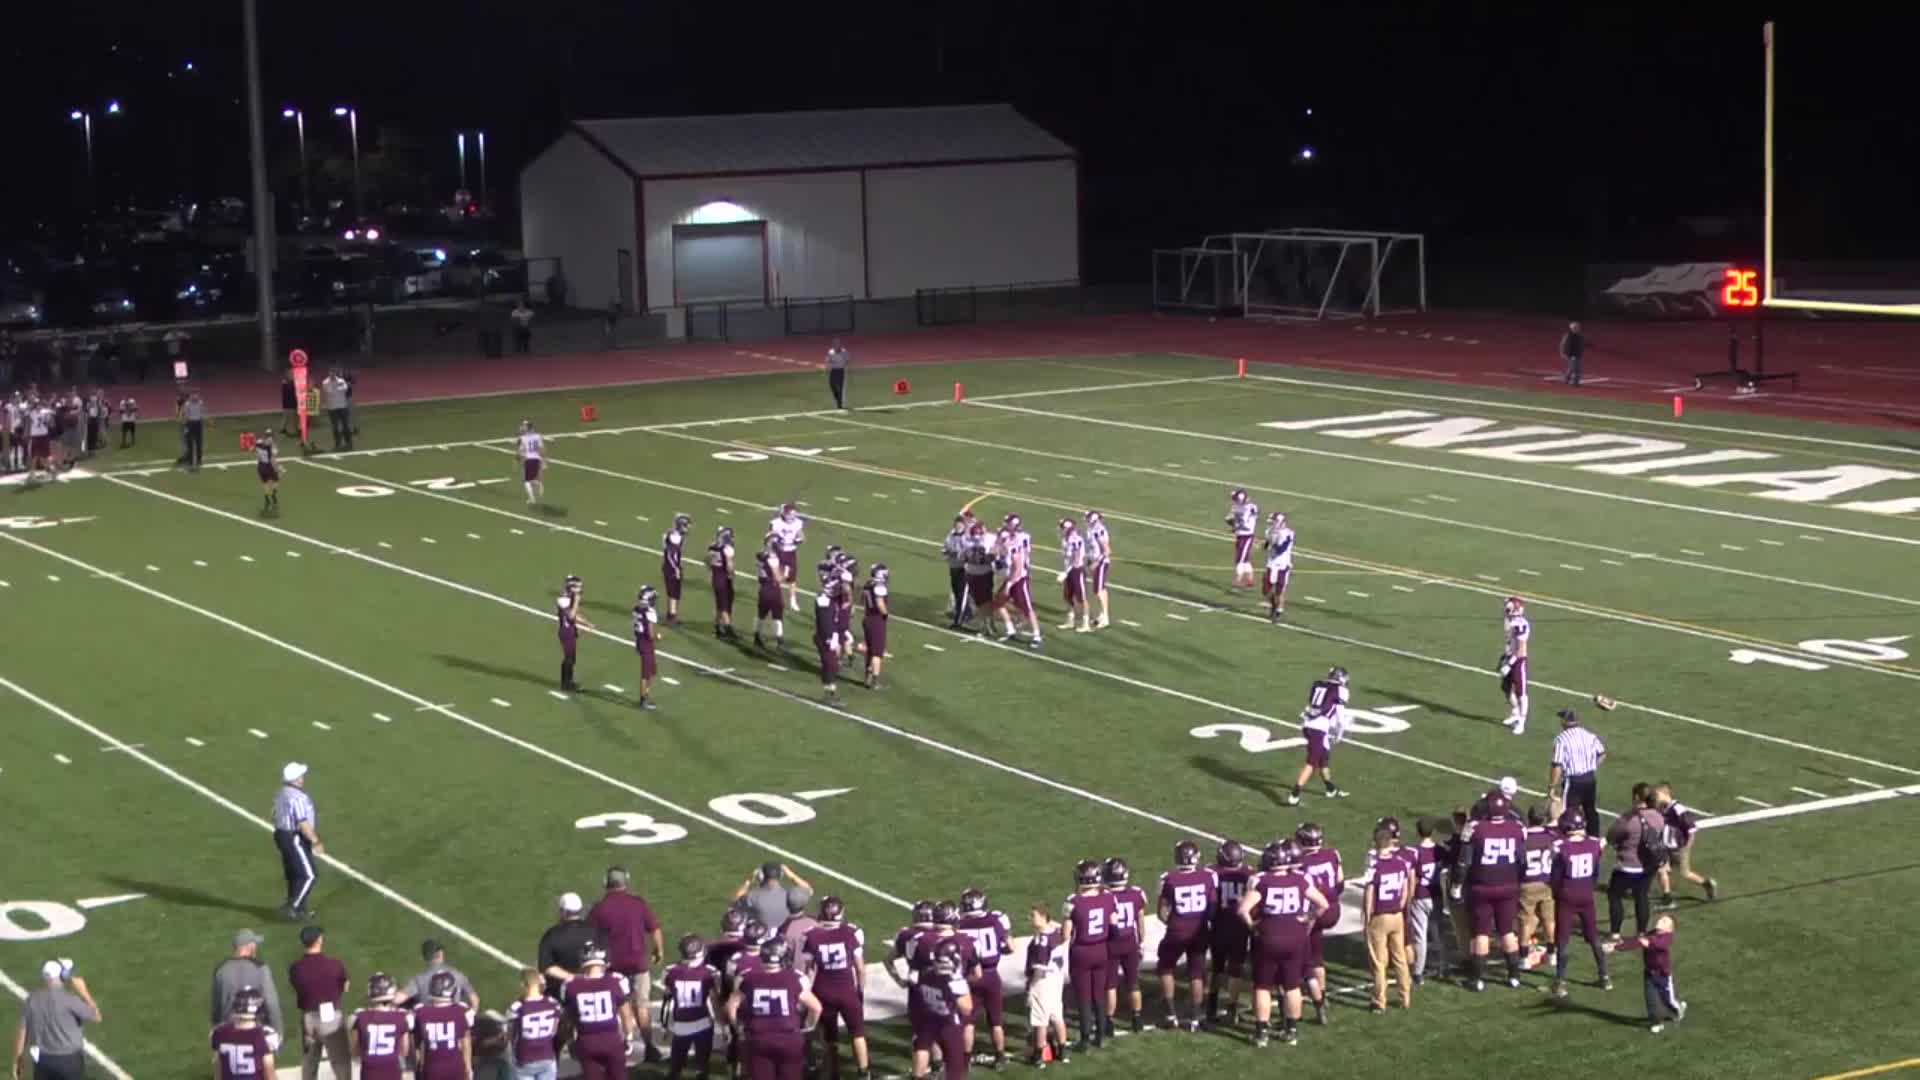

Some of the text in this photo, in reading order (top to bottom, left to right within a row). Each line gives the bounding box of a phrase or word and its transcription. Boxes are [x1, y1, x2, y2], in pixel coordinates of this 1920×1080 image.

[1725, 269, 1758, 306] 25
[1256, 410, 1920, 514] INDIA
[1728, 639, 1910, 671] 10
[1189, 708, 1412, 753] 20
[574, 791, 817, 846] 30
[1481, 838, 1516, 865] 54
[1570, 853, 1593, 878] 18
[1174, 885, 1207, 914] 56
[1265, 886, 1301, 914] 58
[1088, 908, 1104, 935] 2
[675, 980, 702, 1009] 10
[752, 988, 789, 1017] 57
[425, 1022, 456, 1050] 14
[522, 1010, 556, 1040] 55
[366, 1024, 397, 1056] 15
[220, 1043, 256, 1075] 75
